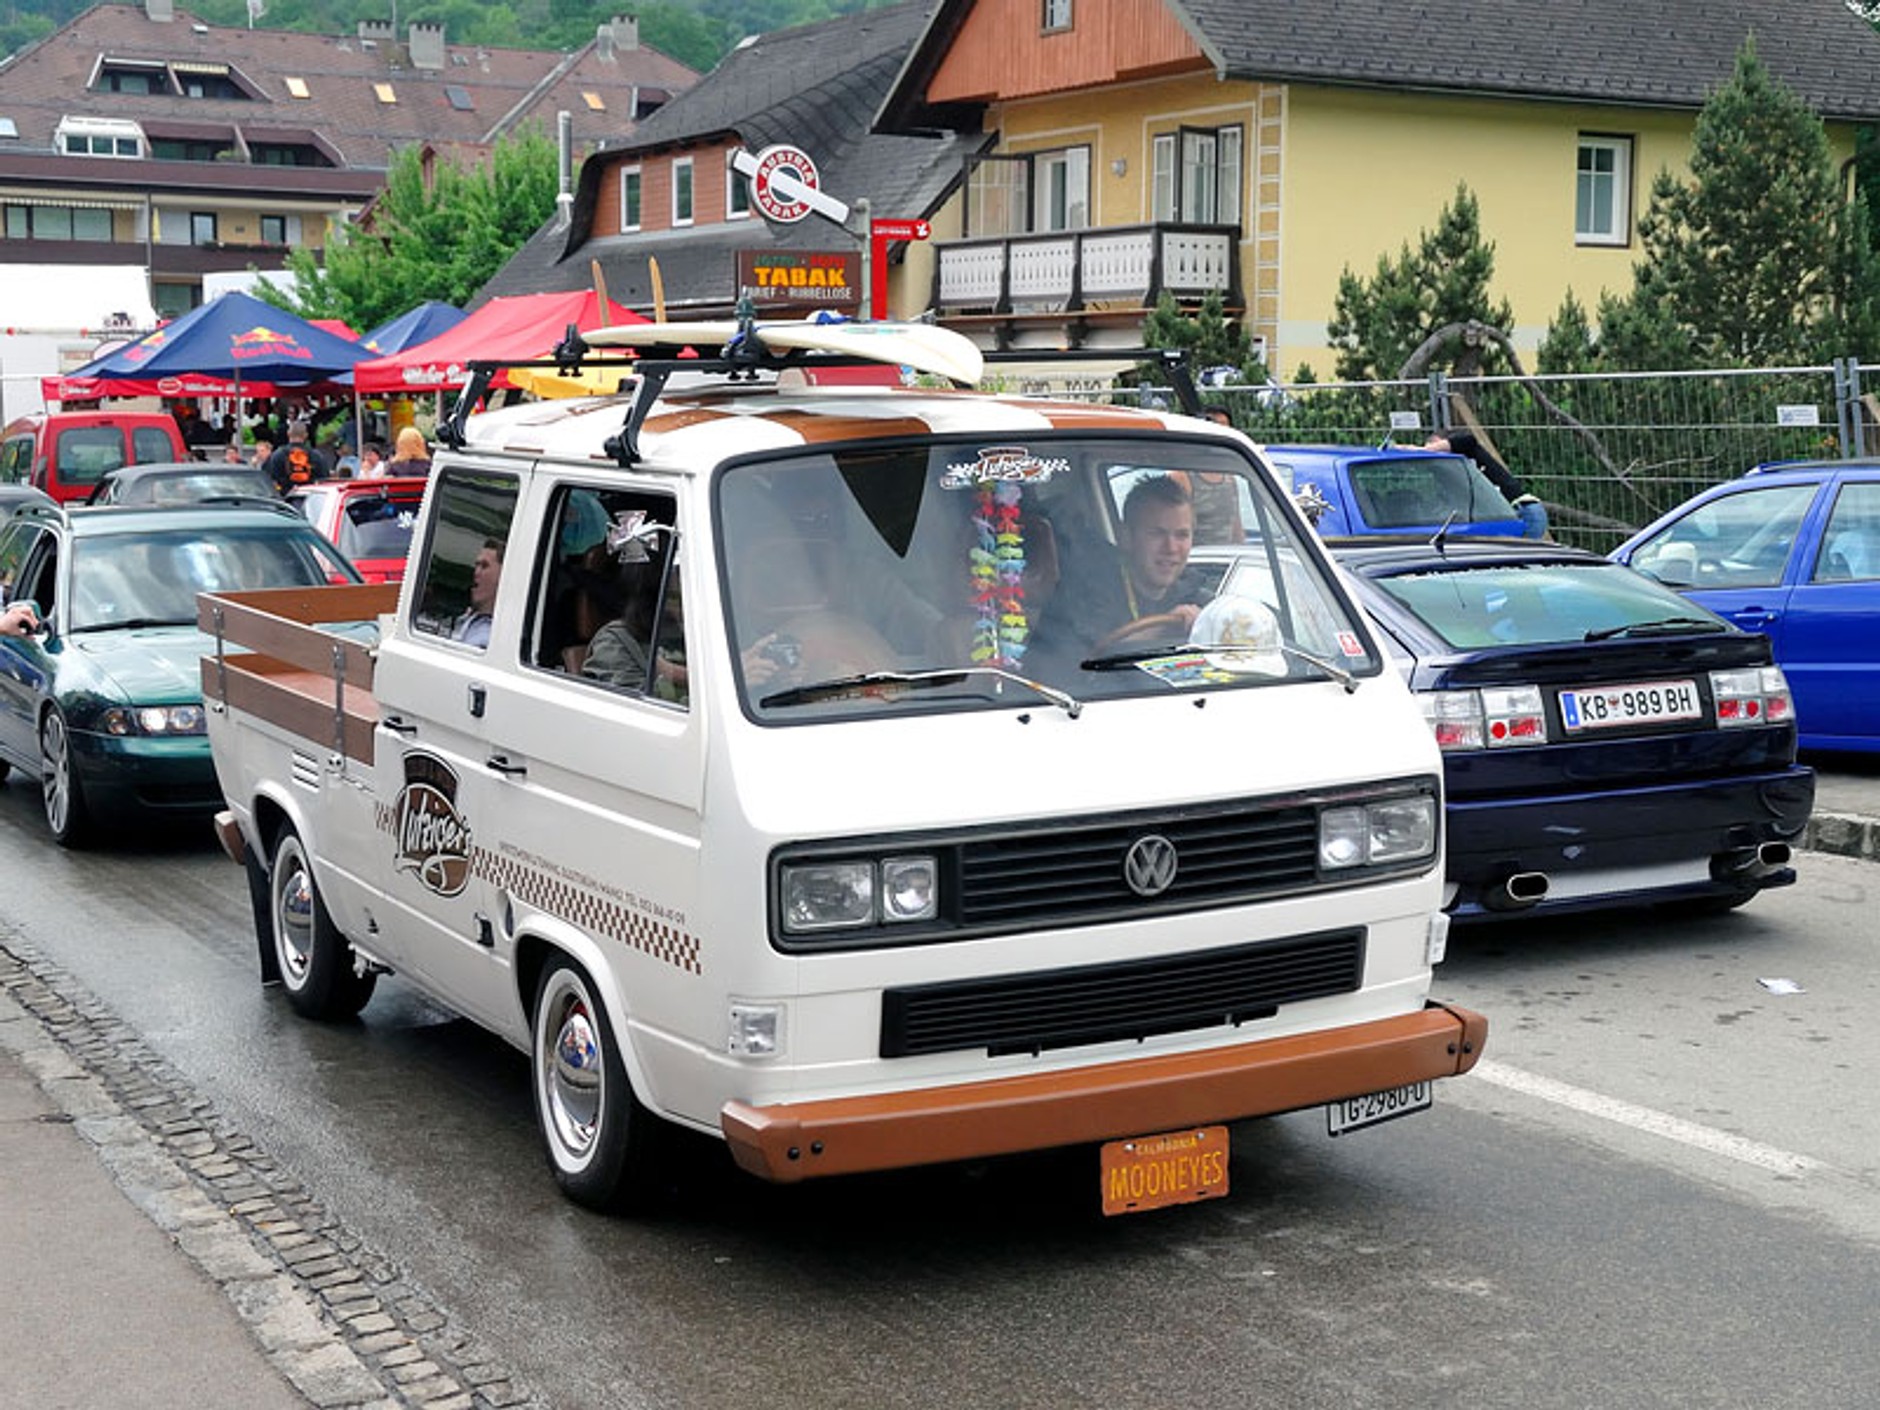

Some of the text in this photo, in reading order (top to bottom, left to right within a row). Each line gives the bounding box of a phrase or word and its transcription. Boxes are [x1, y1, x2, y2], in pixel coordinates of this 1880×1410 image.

[760, 152, 816, 183] AUSTRIA
[759, 189, 805, 218] TABAK
[754, 266, 846, 287] TABAK
[1580, 687, 1693, 720] KB 989 BH
[1126, 835, 1177, 895] VW
[1110, 1151, 1223, 1201] MOONEYES
